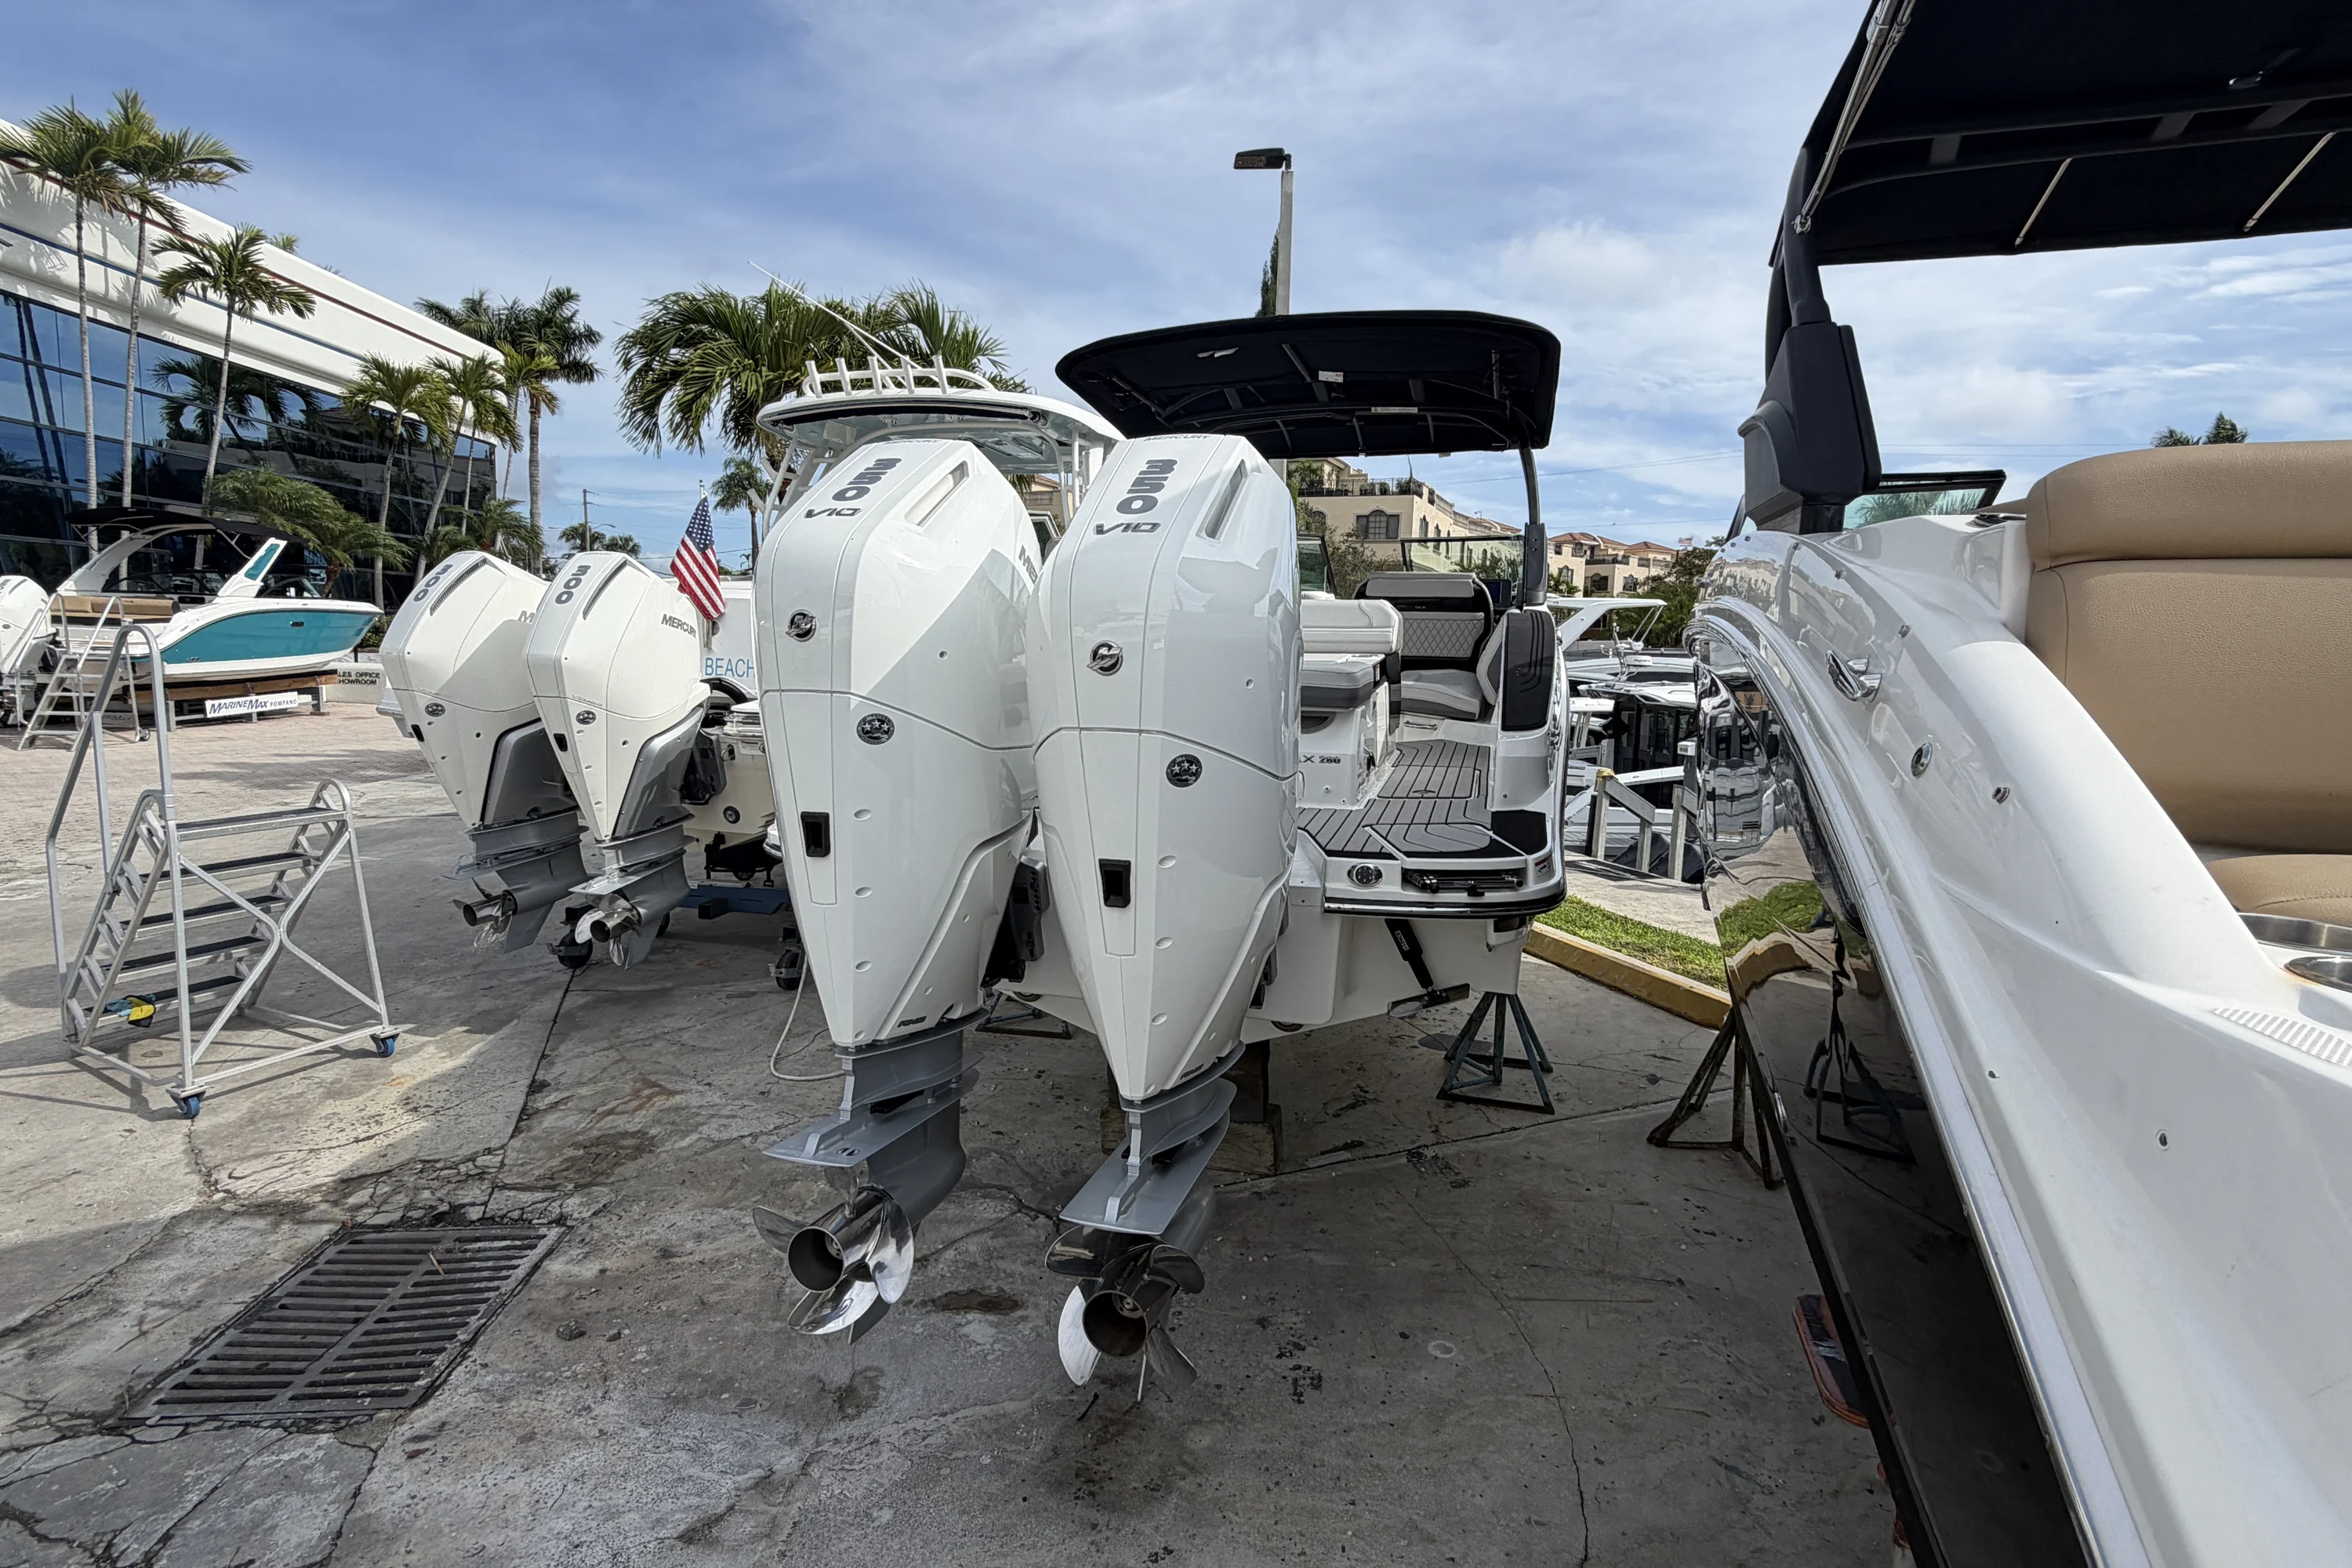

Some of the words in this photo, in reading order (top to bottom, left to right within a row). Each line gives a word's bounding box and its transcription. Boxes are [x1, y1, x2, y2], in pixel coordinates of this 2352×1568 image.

[831, 457, 902, 502] 350
[1116, 459, 1178, 515] 350
[804, 507, 863, 519] V10
[1092, 521, 1162, 535] V10
[413, 564, 453, 602] 300
[554, 564, 592, 605] 300
[661, 613, 696, 639] MERCUR
[705, 657, 755, 678] BEACH
[270, 699, 297, 708] POMPANO
